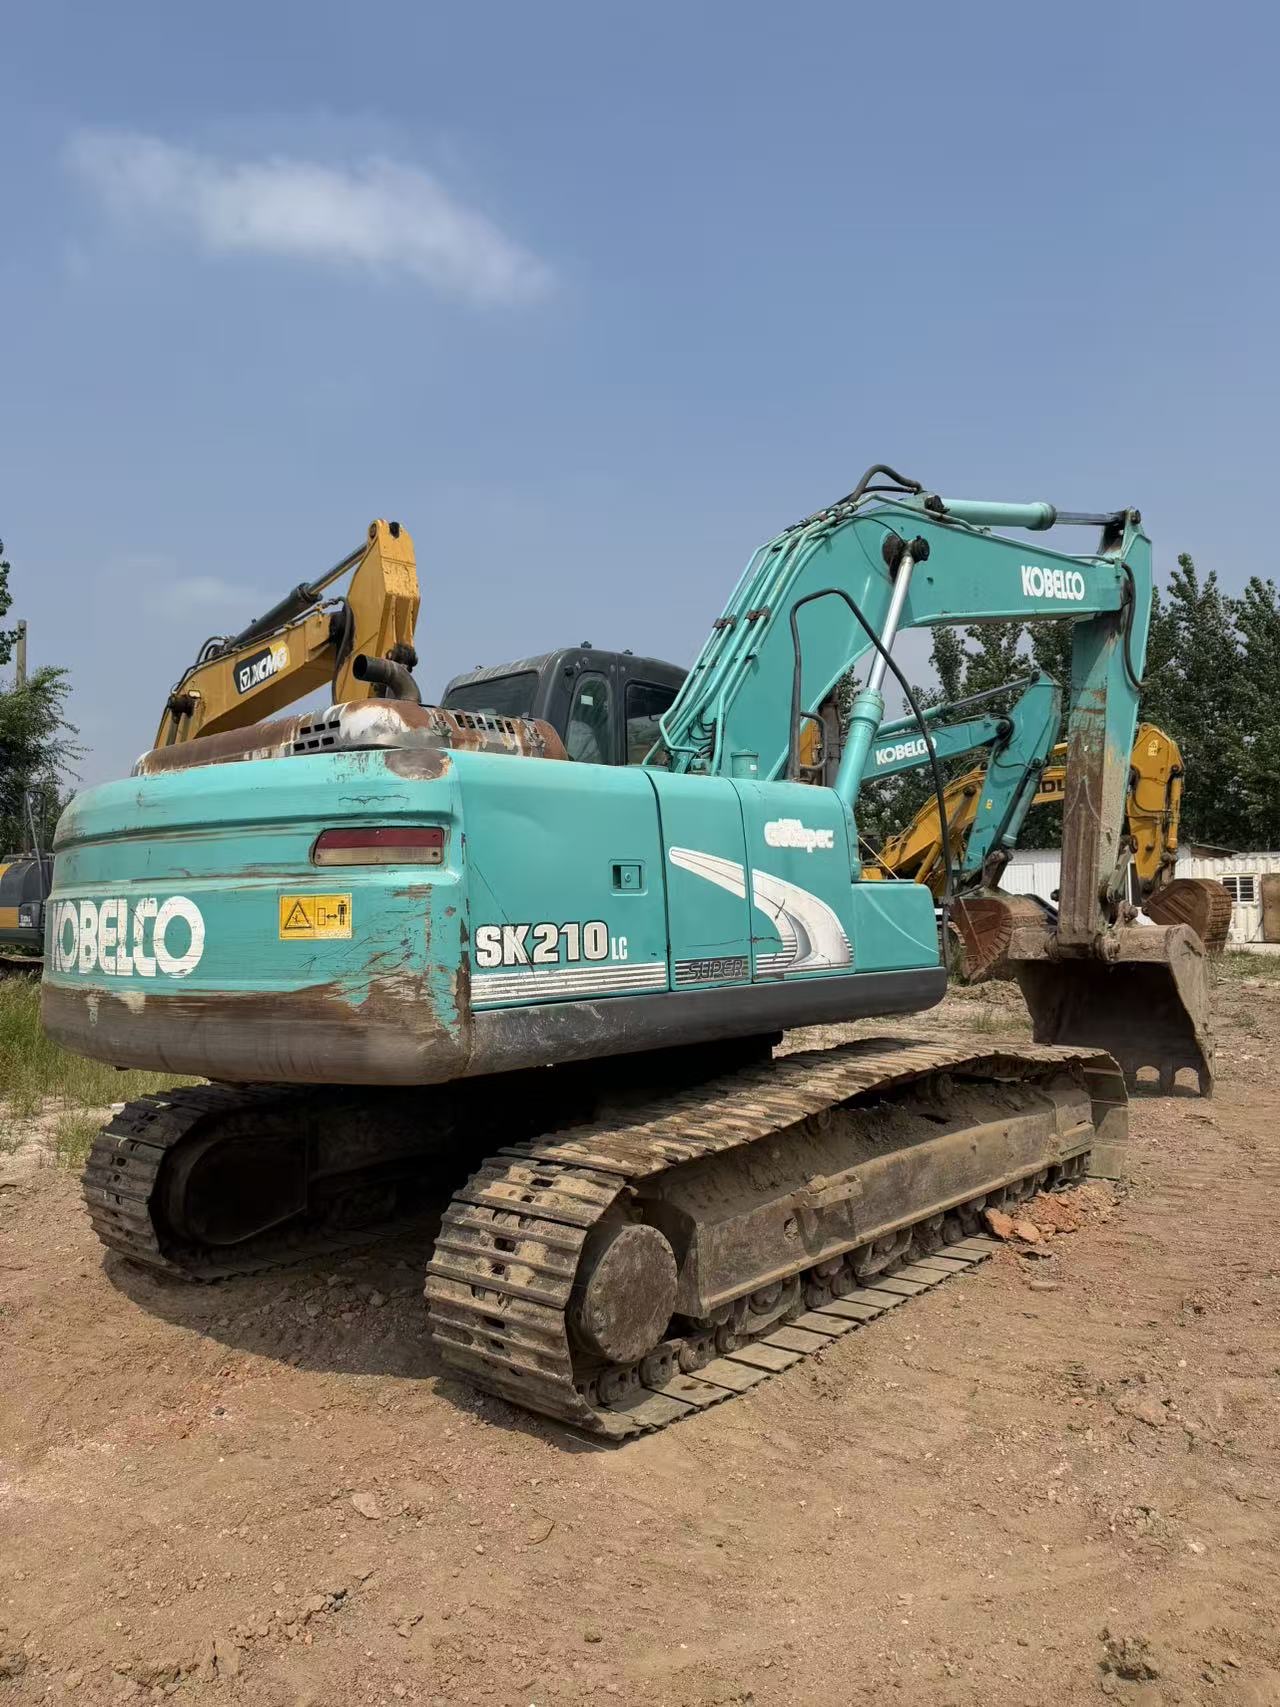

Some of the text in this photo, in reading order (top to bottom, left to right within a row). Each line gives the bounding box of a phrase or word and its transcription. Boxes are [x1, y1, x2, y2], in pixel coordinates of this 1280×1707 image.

[1021, 565, 1085, 600] KOBELCO
[250, 646, 287, 683] XCMG
[51, 895, 205, 979] KOBELCO
[475, 920, 628, 968] SK210 LC
[688, 959, 744, 980] SUPER
